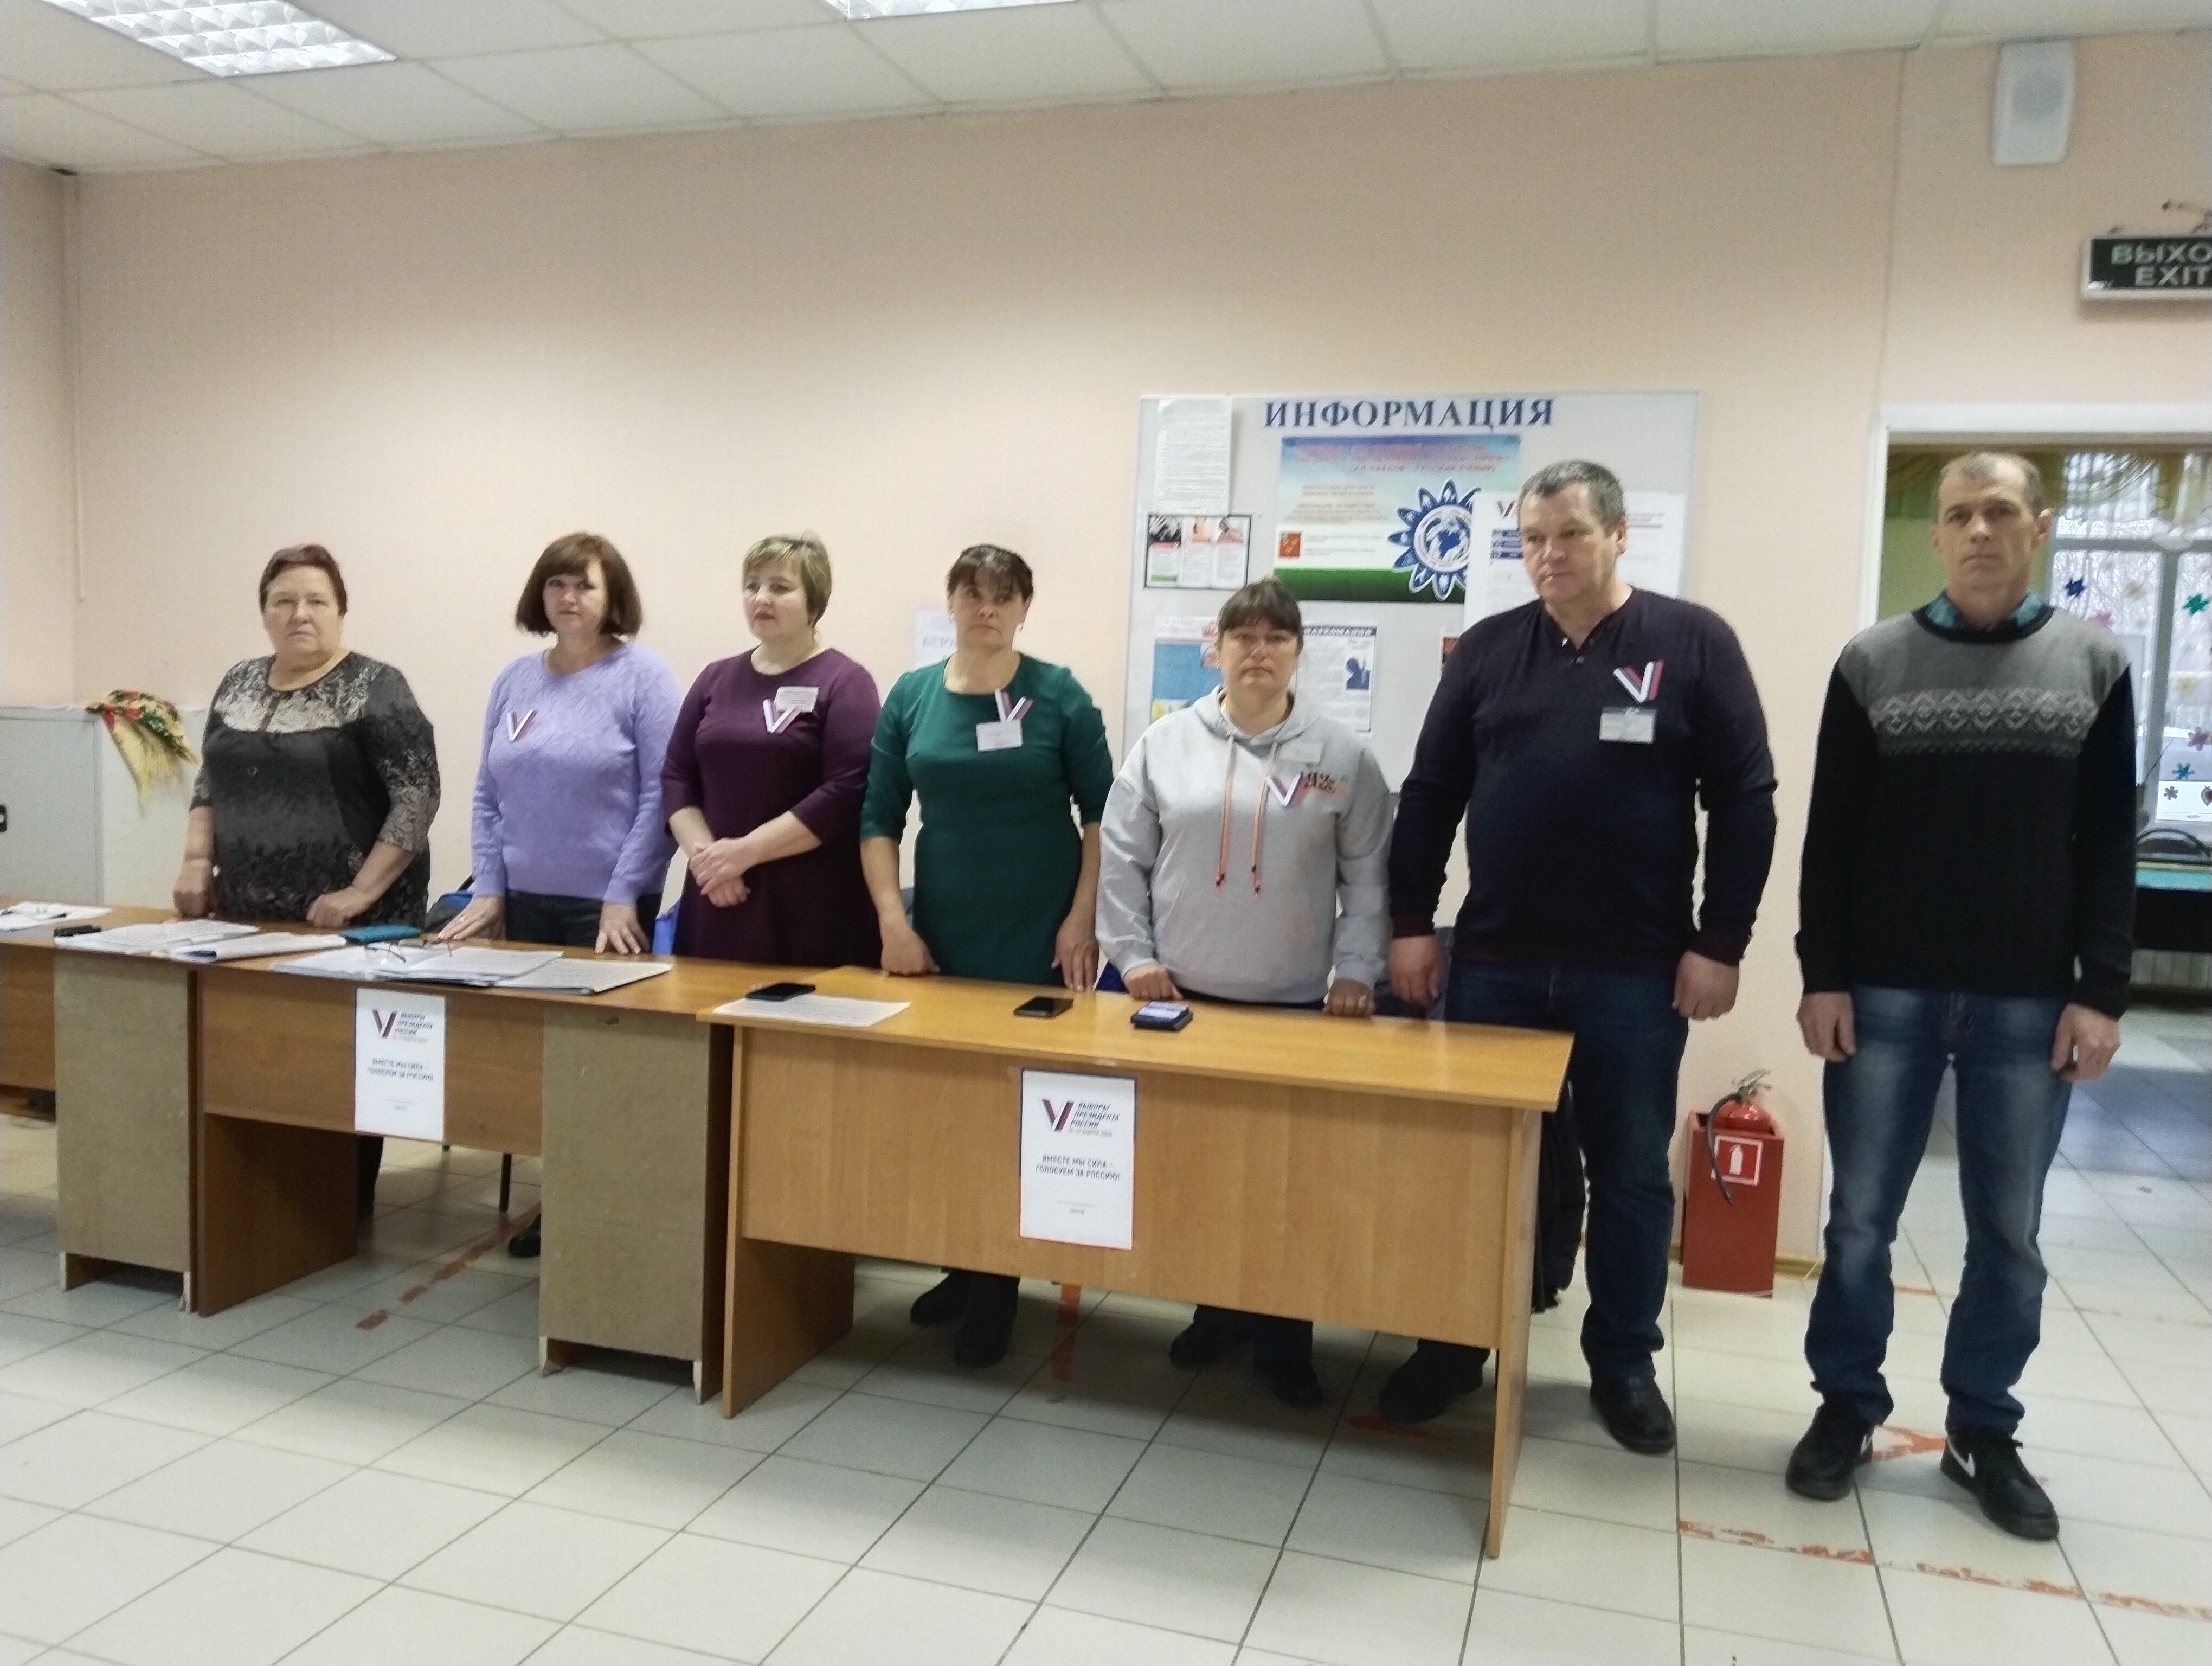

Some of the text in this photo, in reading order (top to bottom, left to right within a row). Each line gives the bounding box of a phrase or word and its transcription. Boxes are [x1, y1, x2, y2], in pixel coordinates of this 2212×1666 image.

[2134, 264, 2212, 286] EXIT
[1265, 399, 1554, 431] ИНФОРМАЦИЯ
[1042, 1154, 1107, 1169] ВМЕСТЕ МЫ СИЛА
[1036, 1164, 1074, 1176] ГОЛОСУЕМ
[1076, 1168, 1084, 1178] ЗА
